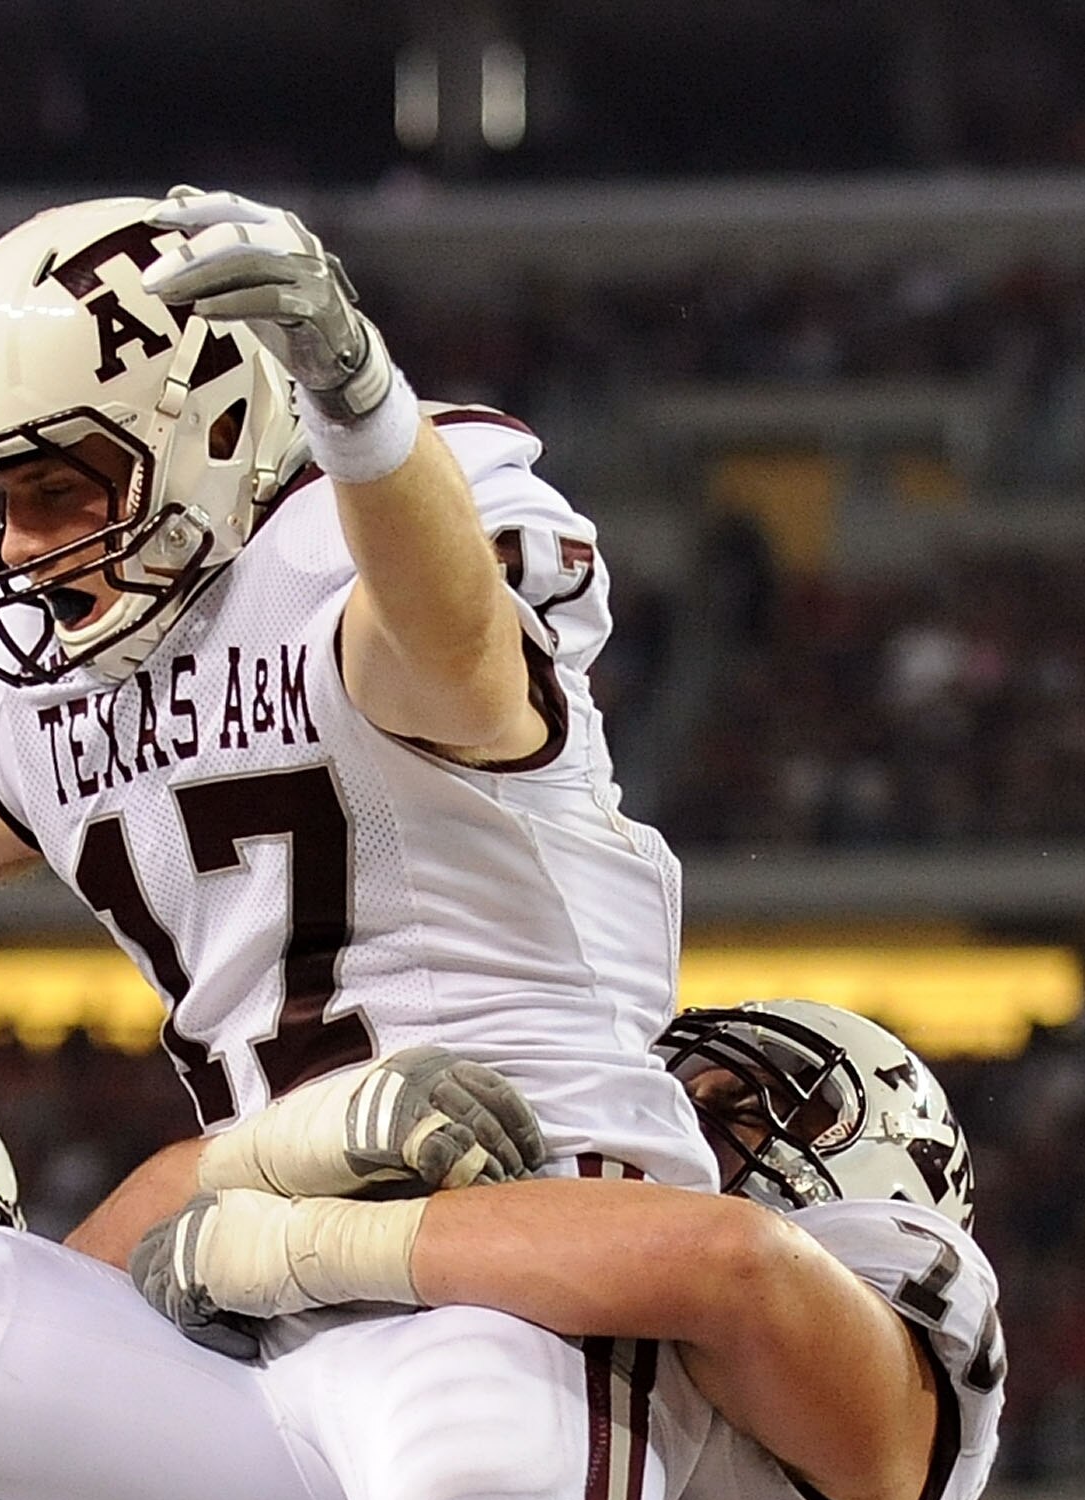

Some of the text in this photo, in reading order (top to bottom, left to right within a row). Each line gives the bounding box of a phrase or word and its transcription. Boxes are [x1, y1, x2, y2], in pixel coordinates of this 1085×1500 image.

[37, 644, 320, 805] TEXAS A&M
[72, 761, 380, 1137] 17
